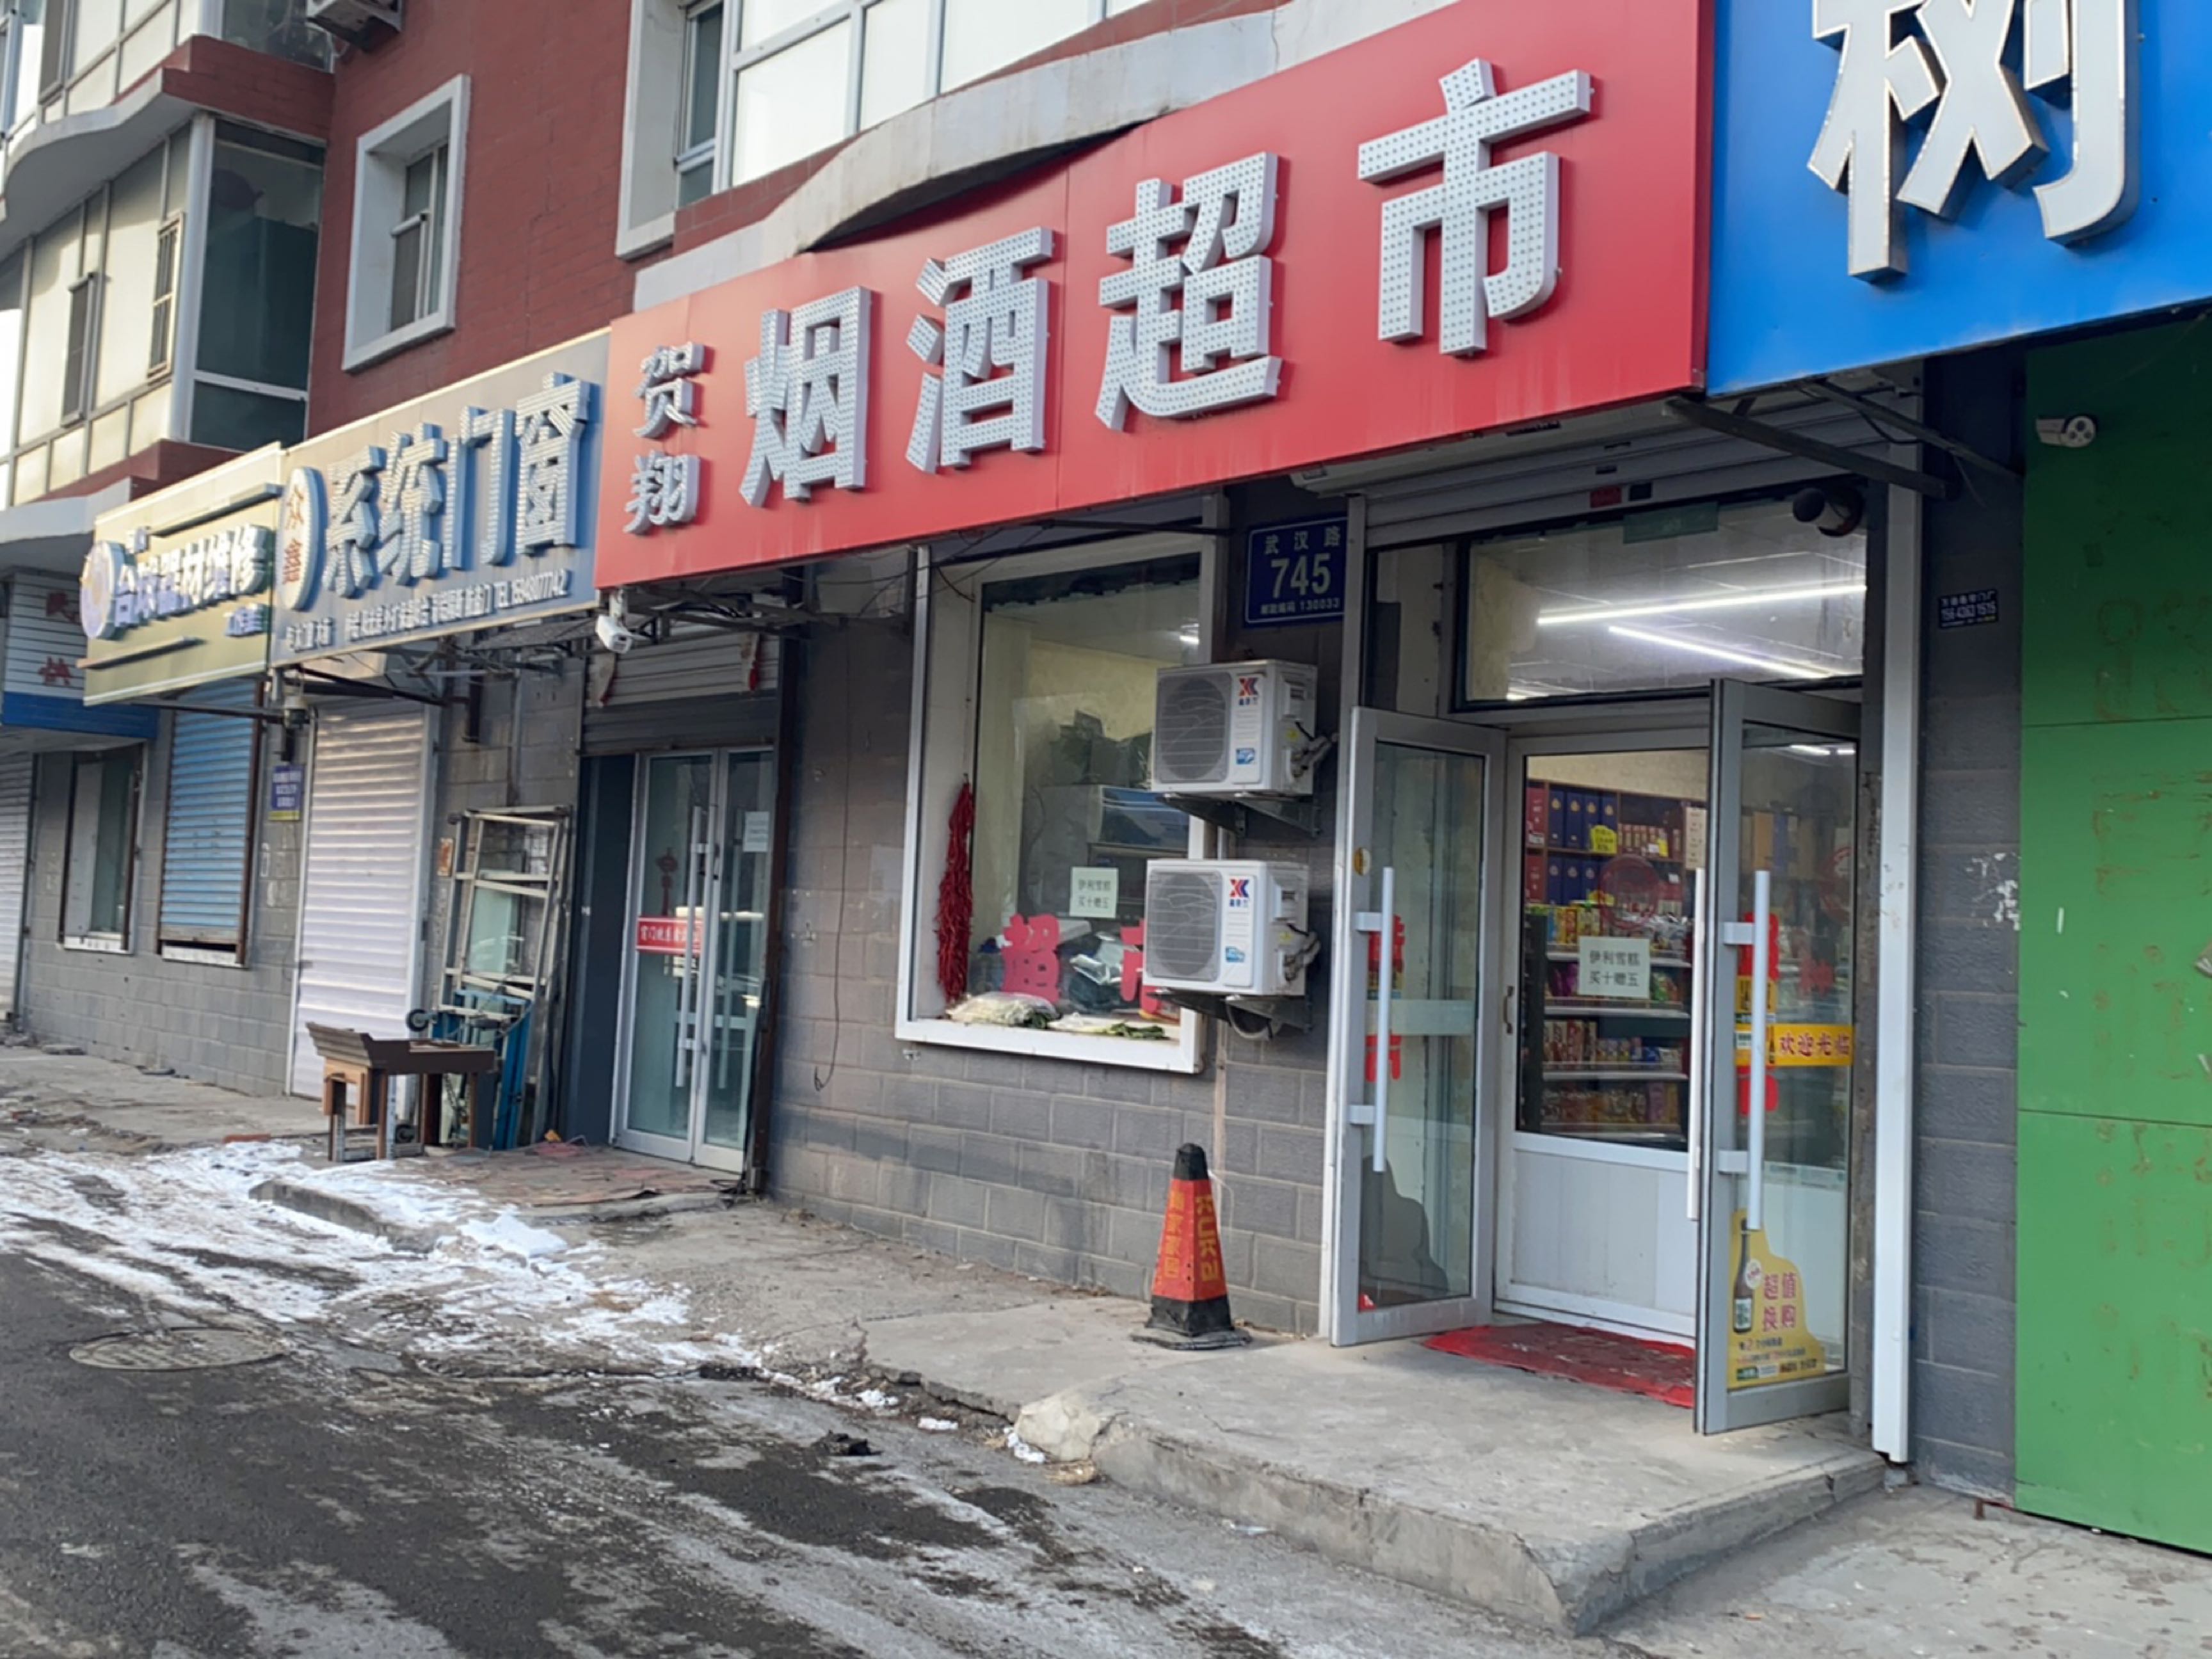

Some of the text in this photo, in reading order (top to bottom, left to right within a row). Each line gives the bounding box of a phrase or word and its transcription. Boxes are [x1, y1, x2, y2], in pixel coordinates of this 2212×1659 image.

[739, 58, 1594, 508] 烟酒超市
[625, 341, 704, 536] 贺翔
[322, 372, 590, 598] 系统门窗
[1265, 525, 1340, 555] 武汉路
[1270, 552, 1331, 598] 745
[1589, 950, 1640, 966] 伊利雪糕
[1587, 970, 1639, 986] 买十赠五
[1779, 1032, 1850, 1057] 欢迎光临
